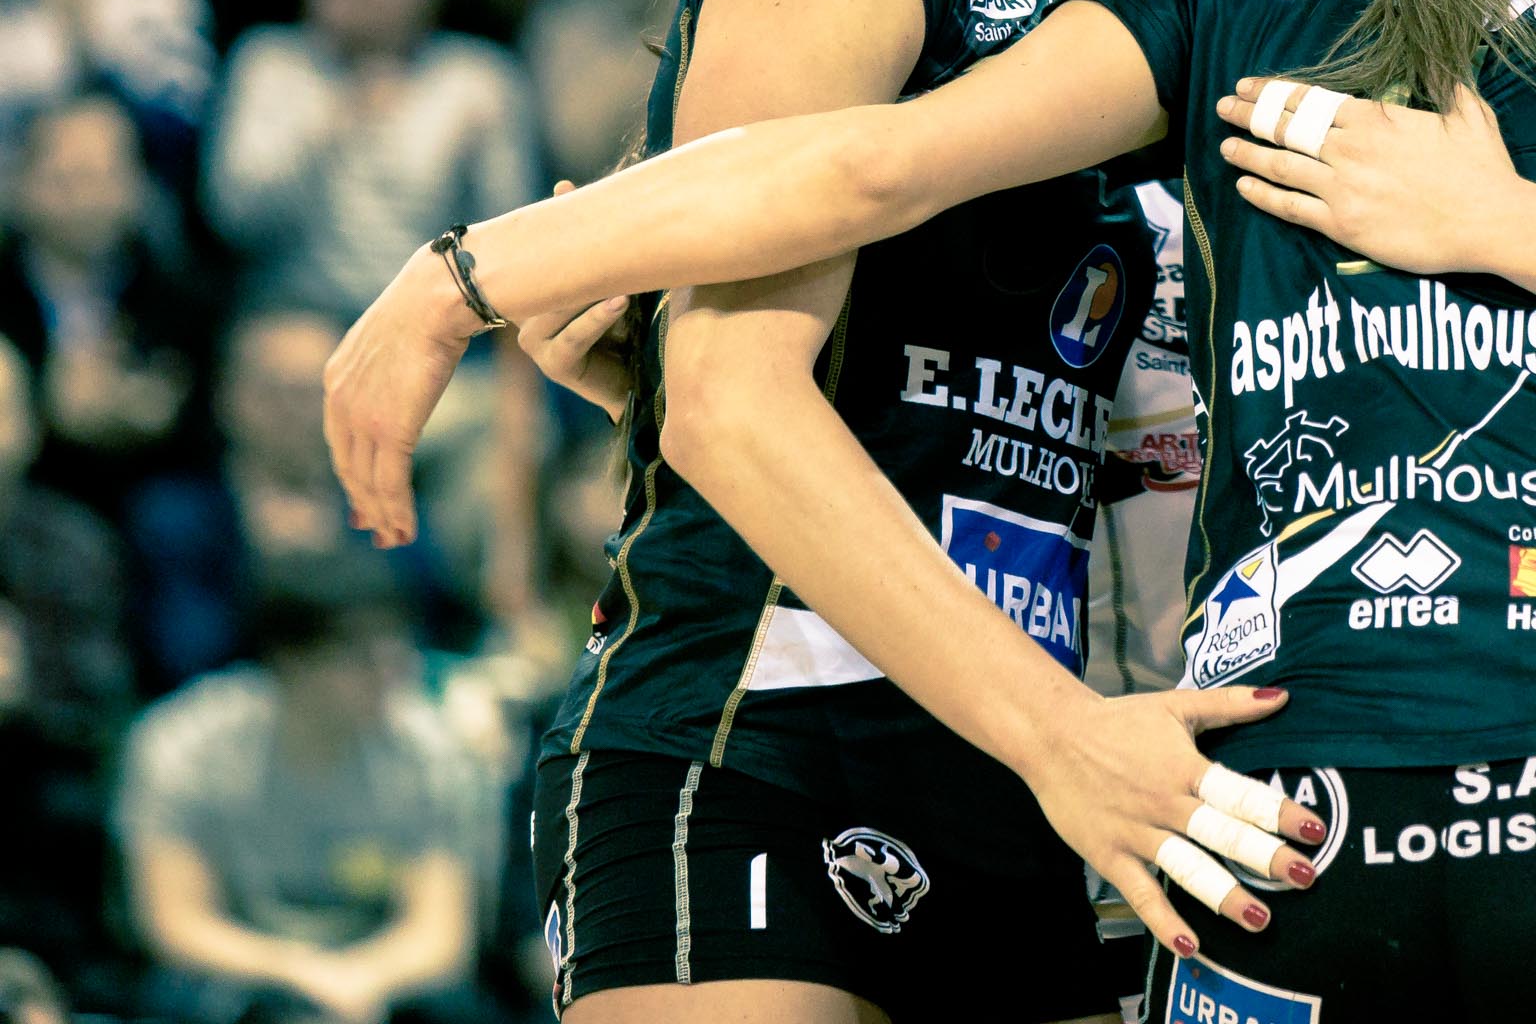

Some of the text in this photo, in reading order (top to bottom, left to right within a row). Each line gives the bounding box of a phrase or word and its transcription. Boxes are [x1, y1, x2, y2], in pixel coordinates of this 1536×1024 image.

[1230, 276, 1347, 409] asptt
[1199, 641, 1273, 685] Alsace
[1206, 612, 1268, 655] Région
[750, 852, 767, 929] 1
